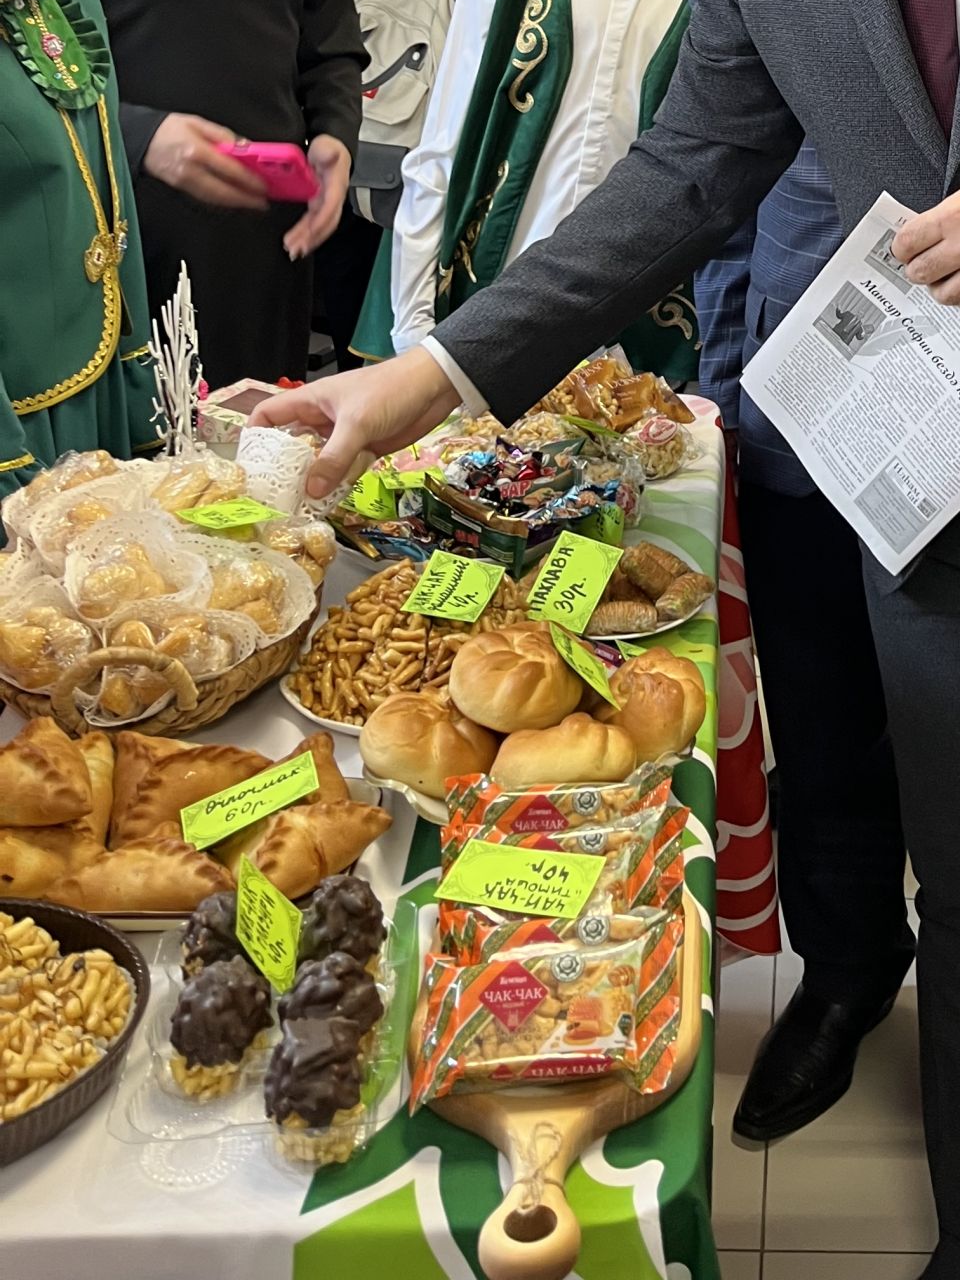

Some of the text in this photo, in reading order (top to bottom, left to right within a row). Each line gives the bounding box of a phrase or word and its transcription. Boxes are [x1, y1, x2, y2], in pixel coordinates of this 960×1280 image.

[859, 277, 902, 319] Мансур
[901, 318, 933, 357] Сафин
[530, 547, 575, 611] ПАХЛАВА
[515, 820, 565, 831] ЧАК-ЧАК
[480, 883, 565, 912] ЧАК-ЧАК
[484, 988, 543, 1003] ЧАК-ЧАК
